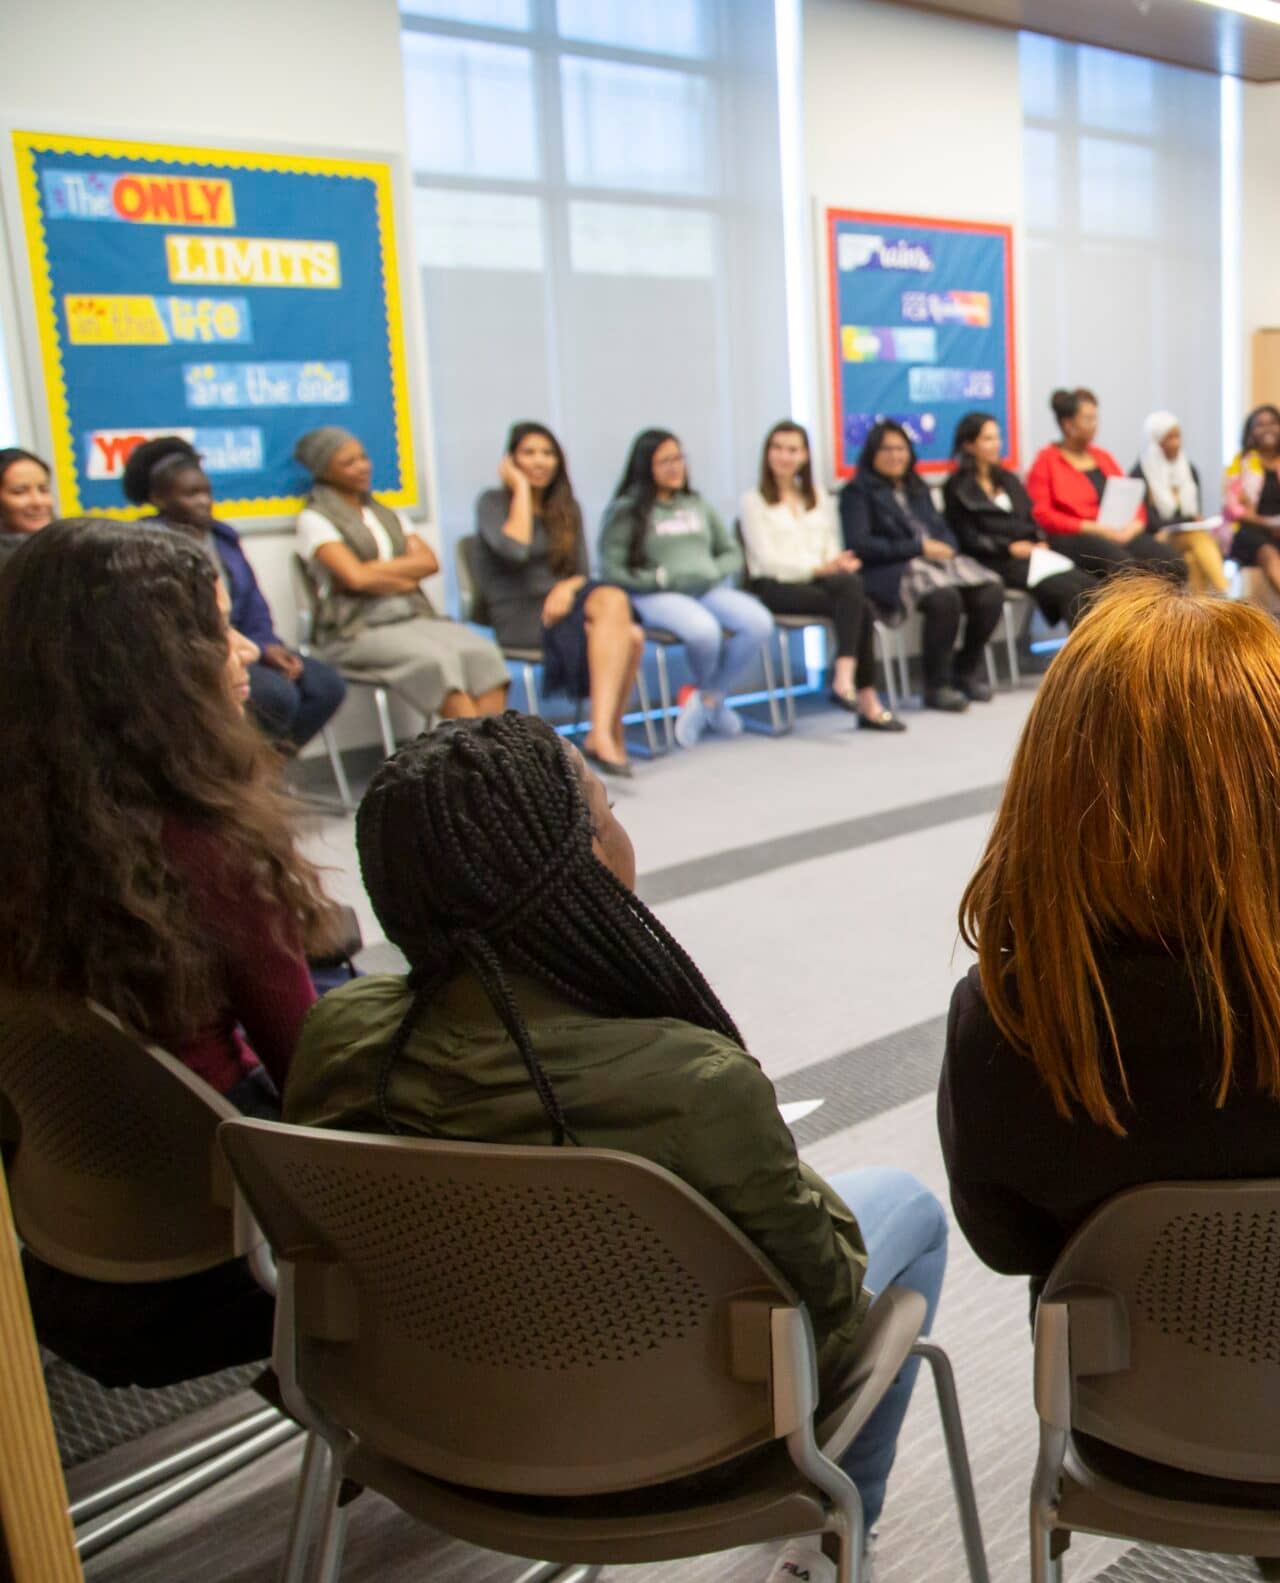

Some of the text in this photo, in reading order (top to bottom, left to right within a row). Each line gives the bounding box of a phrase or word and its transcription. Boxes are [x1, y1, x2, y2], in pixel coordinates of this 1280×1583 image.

[63, 176, 222, 222] The ONLY
[173, 237, 337, 287] LIMITS
[169, 297, 240, 342] life
[191, 381, 238, 406] are
[246, 365, 290, 405] the
[782, 1561, 811, 1581] FILA
